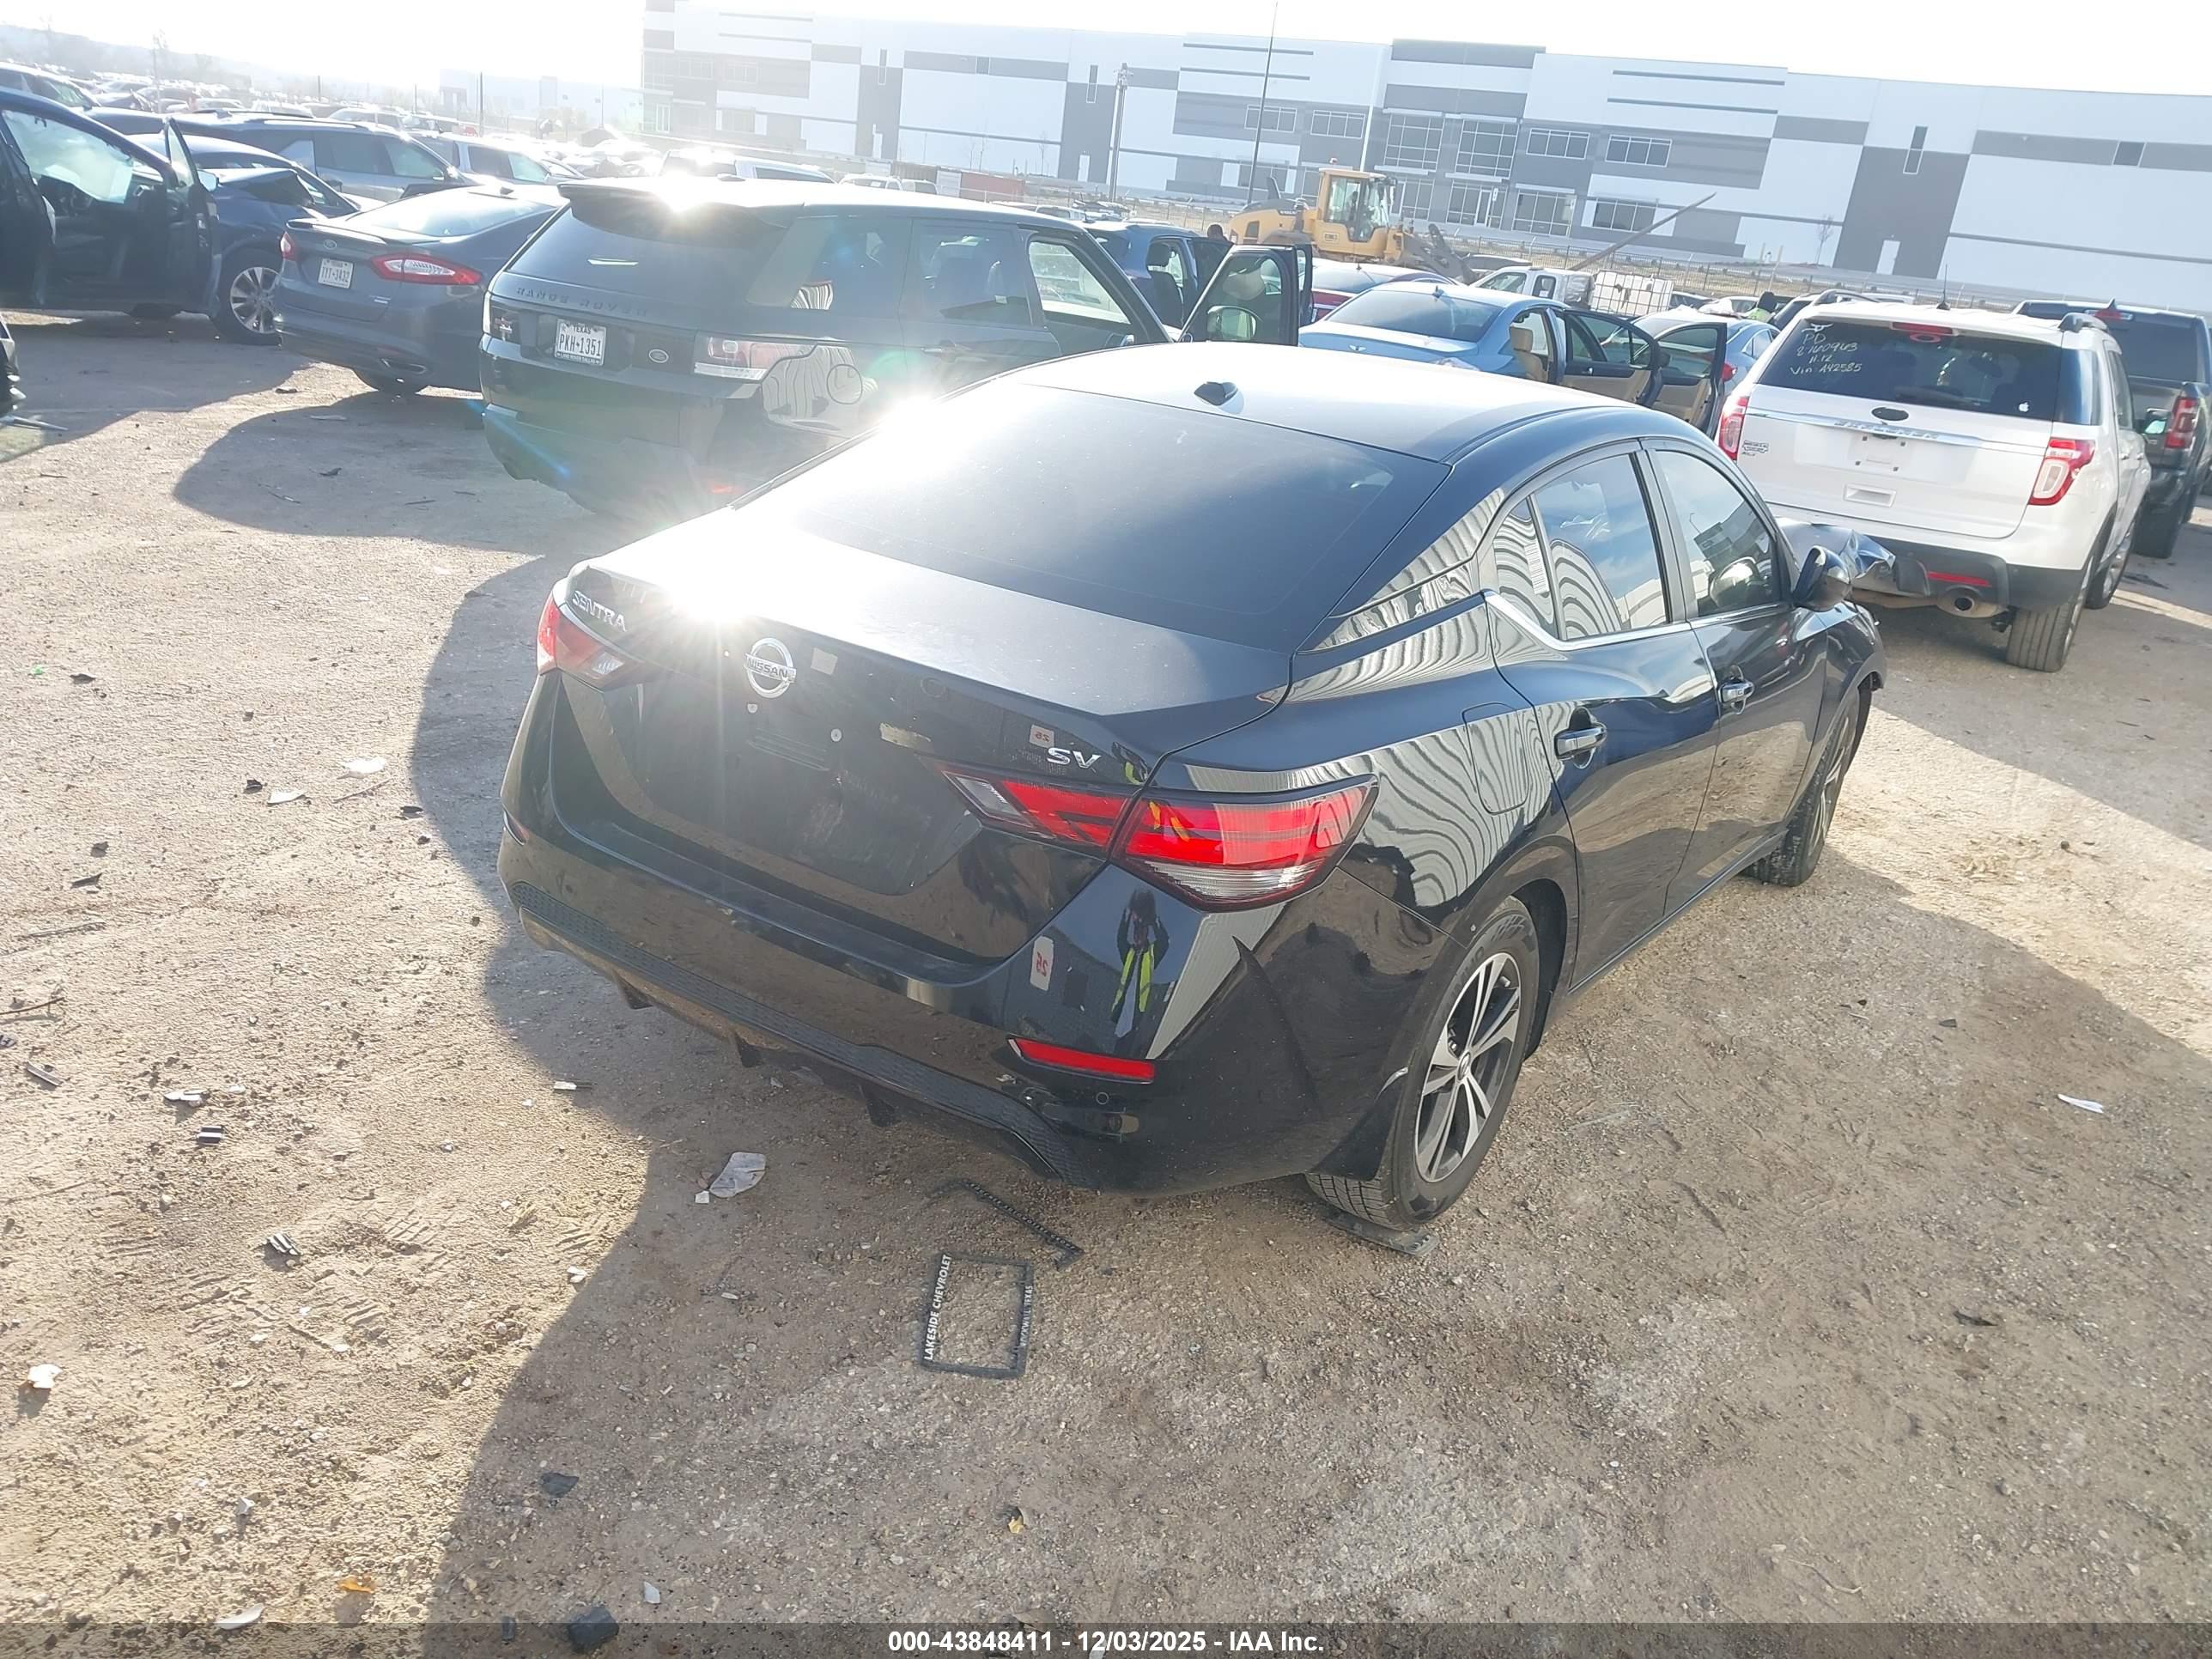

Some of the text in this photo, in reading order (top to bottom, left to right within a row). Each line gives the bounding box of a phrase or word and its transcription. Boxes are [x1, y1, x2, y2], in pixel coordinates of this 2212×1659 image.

[1803, 332, 1826, 344] PD
[572, 590, 628, 633] SENTRA
[747, 657, 788, 678] NISSAN
[1047, 747, 1101, 769] SV
[924, 1254, 952, 1361] LAKESIDE CHEVROLET
